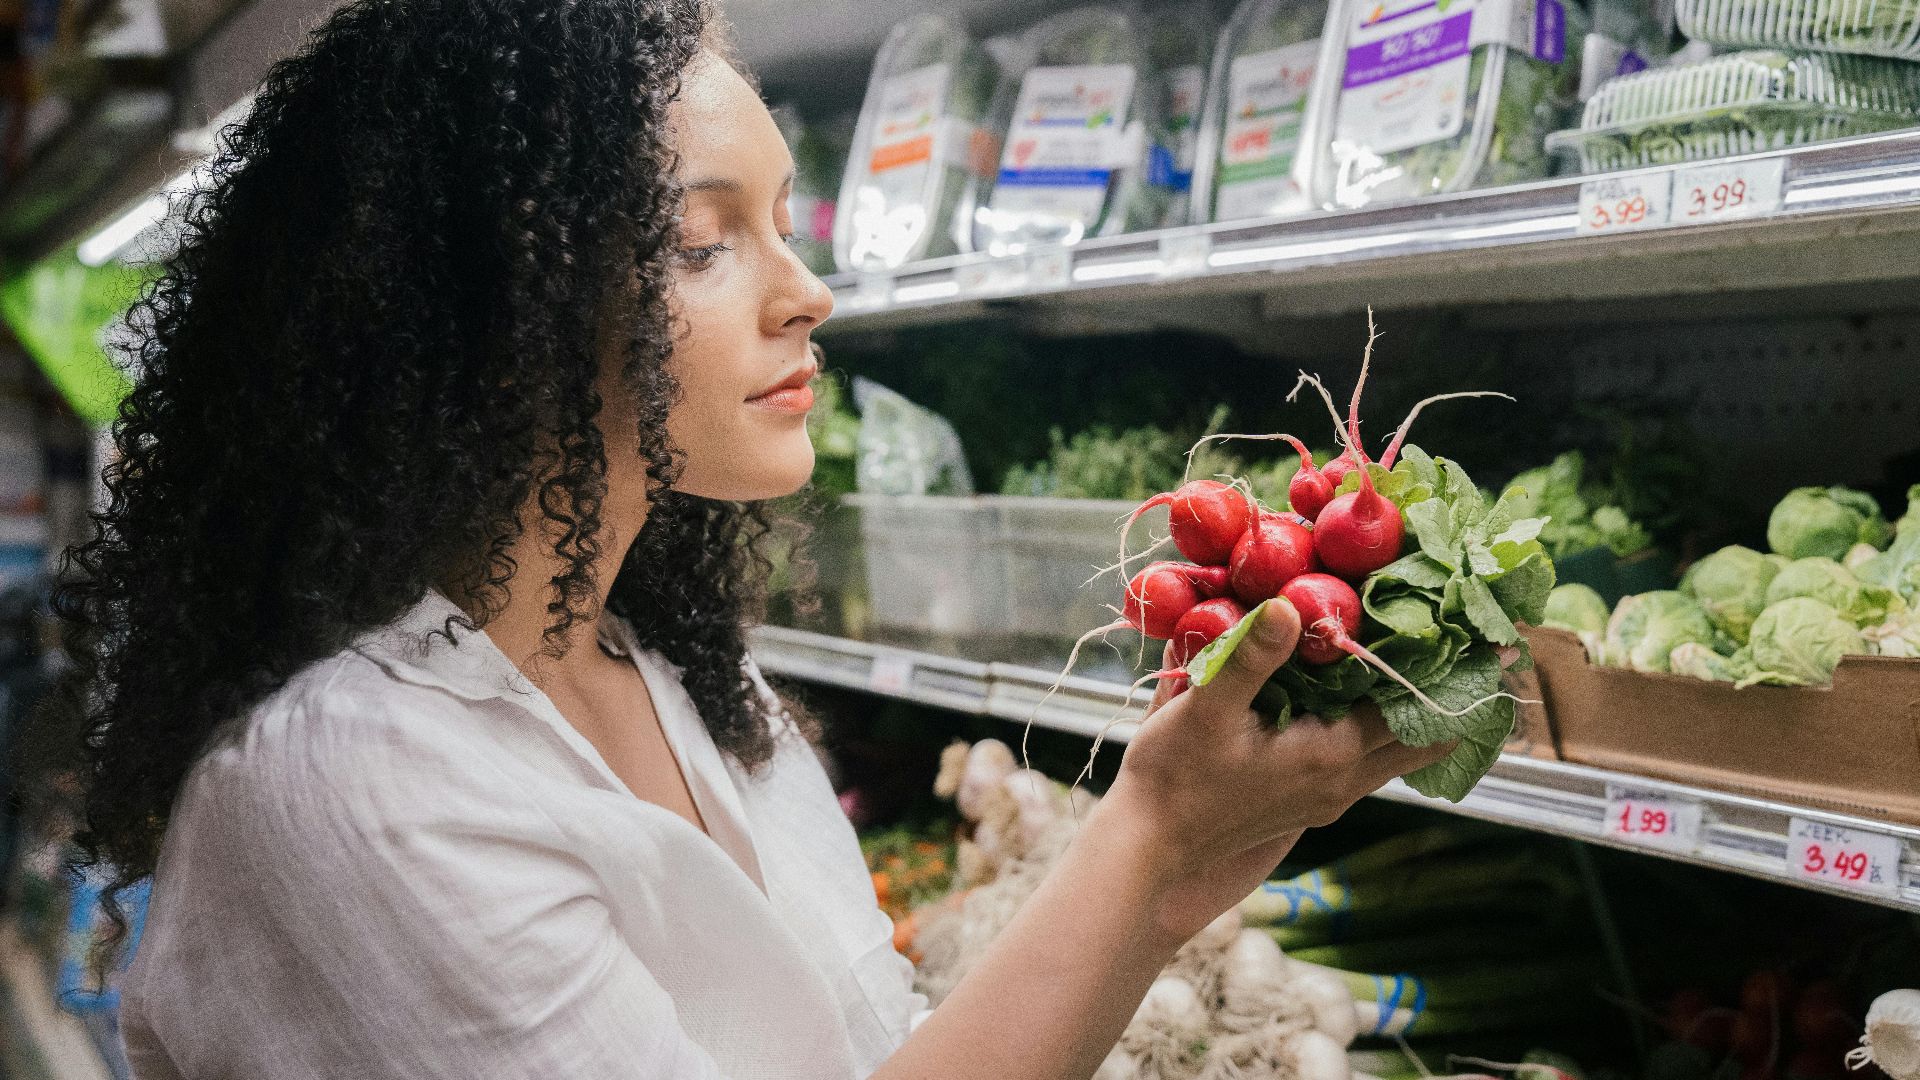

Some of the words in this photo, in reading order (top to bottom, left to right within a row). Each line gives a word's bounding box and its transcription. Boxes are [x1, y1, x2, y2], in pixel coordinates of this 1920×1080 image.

[1589, 195, 1647, 229] 3.99
[1687, 177, 1747, 217] 3.99
[1619, 803, 1667, 833] 1.99
[1803, 844, 1868, 880] 3.49
